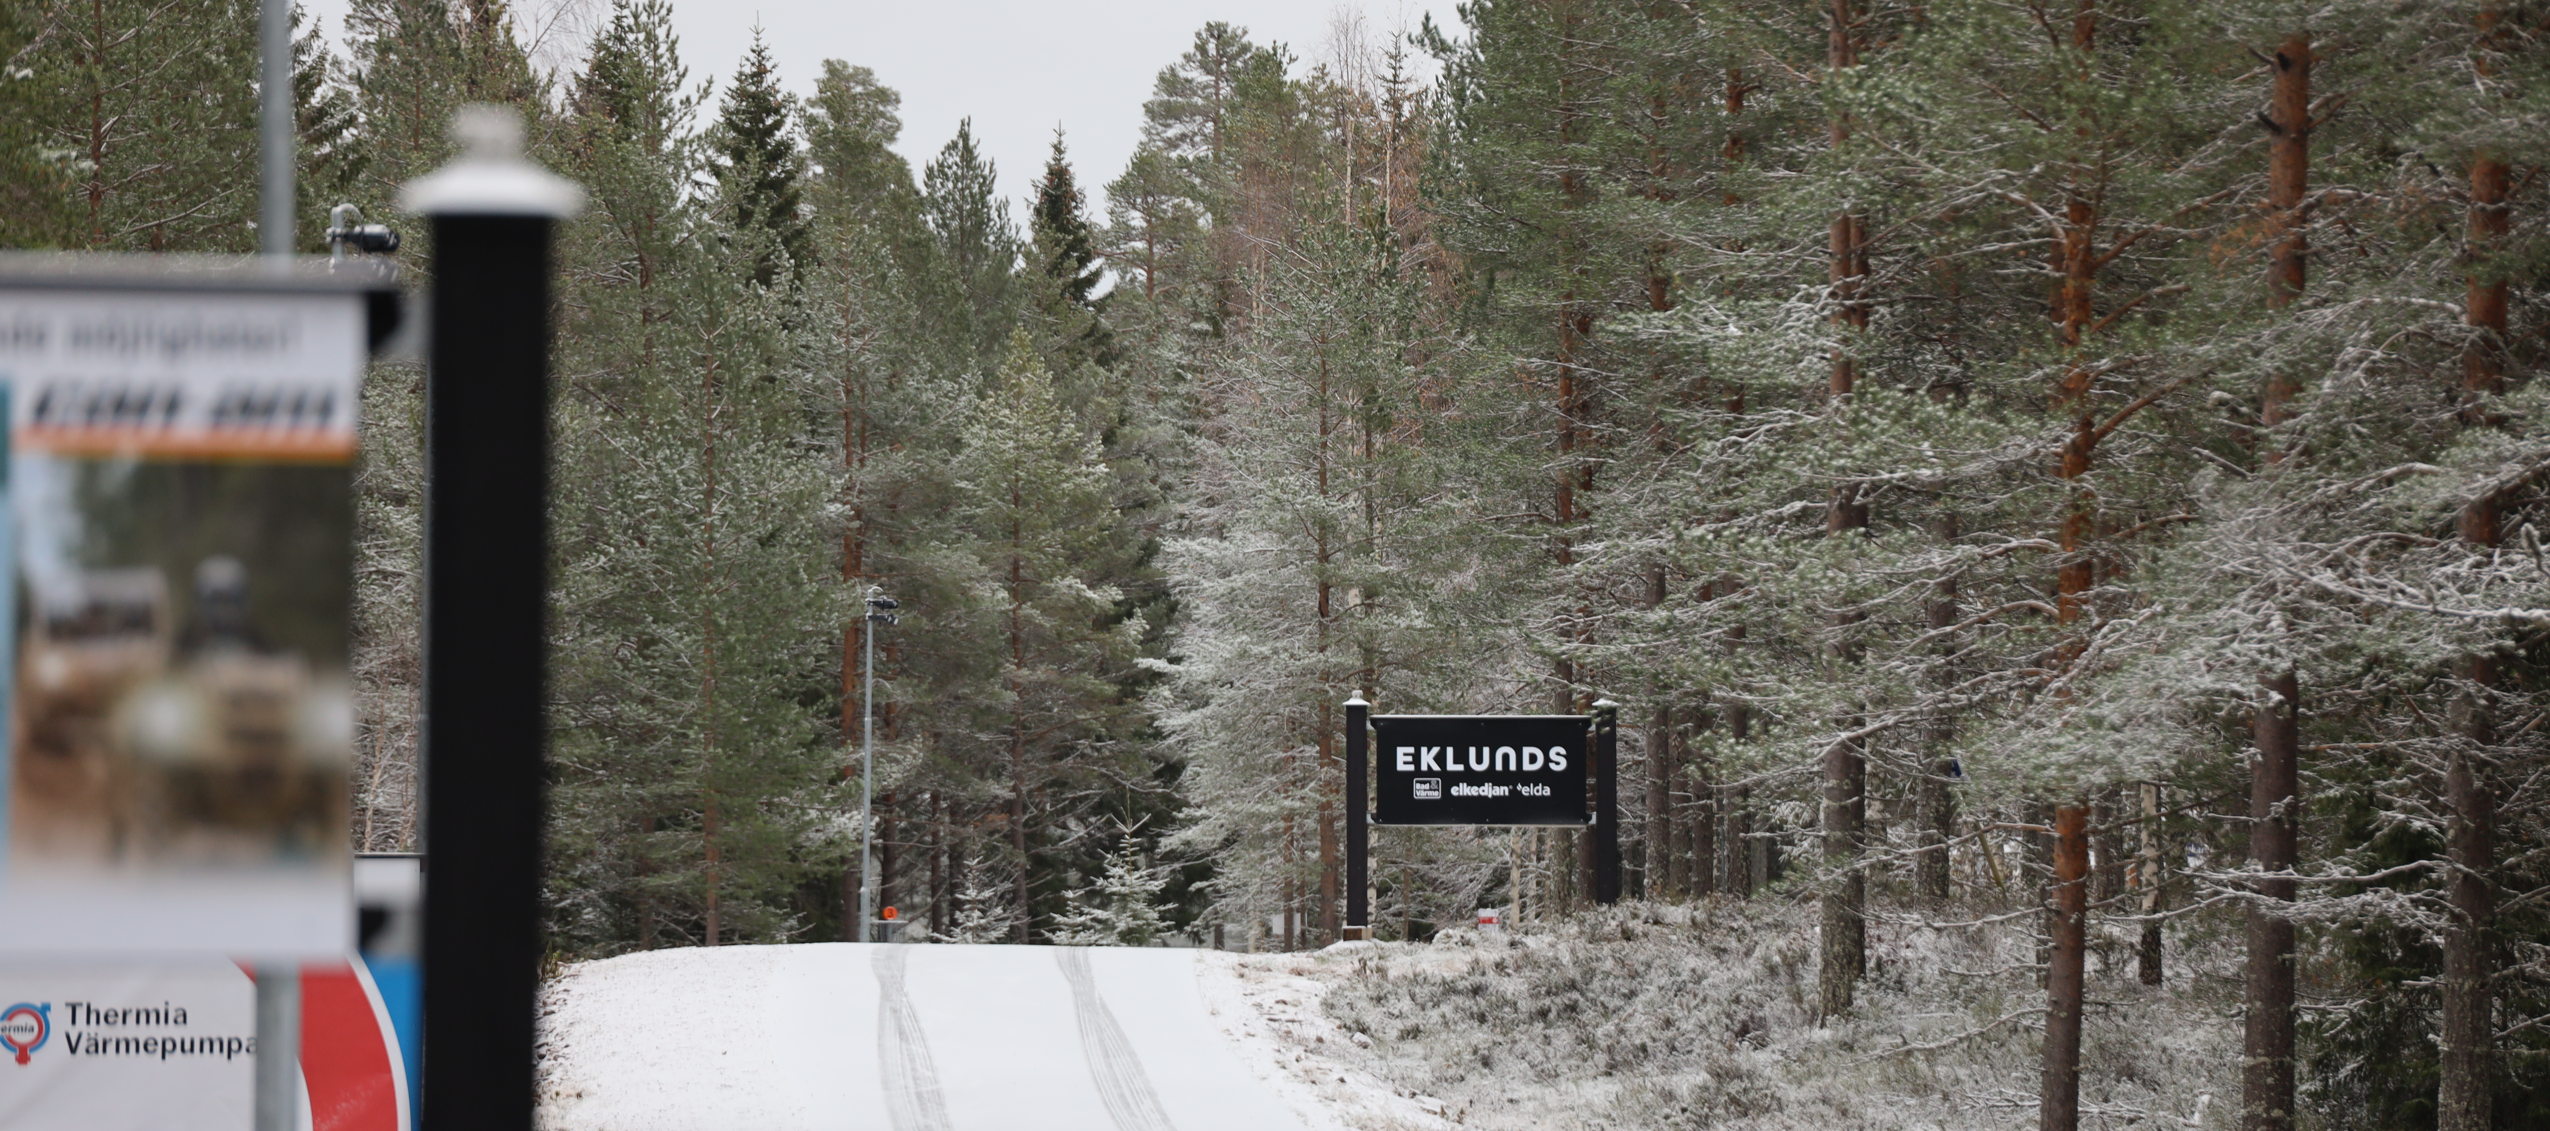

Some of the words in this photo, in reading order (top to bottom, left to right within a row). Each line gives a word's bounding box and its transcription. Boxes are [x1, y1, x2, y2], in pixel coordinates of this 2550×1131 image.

[1396, 746, 1568, 772] EKLUNDS
[1430, 779, 1439, 790] &
[1450, 782, 1509, 798] elkedjan
[1521, 782, 1551, 796] elda
[1415, 789, 1440, 798] Värme
[65, 1001, 188, 1026] Thermia
